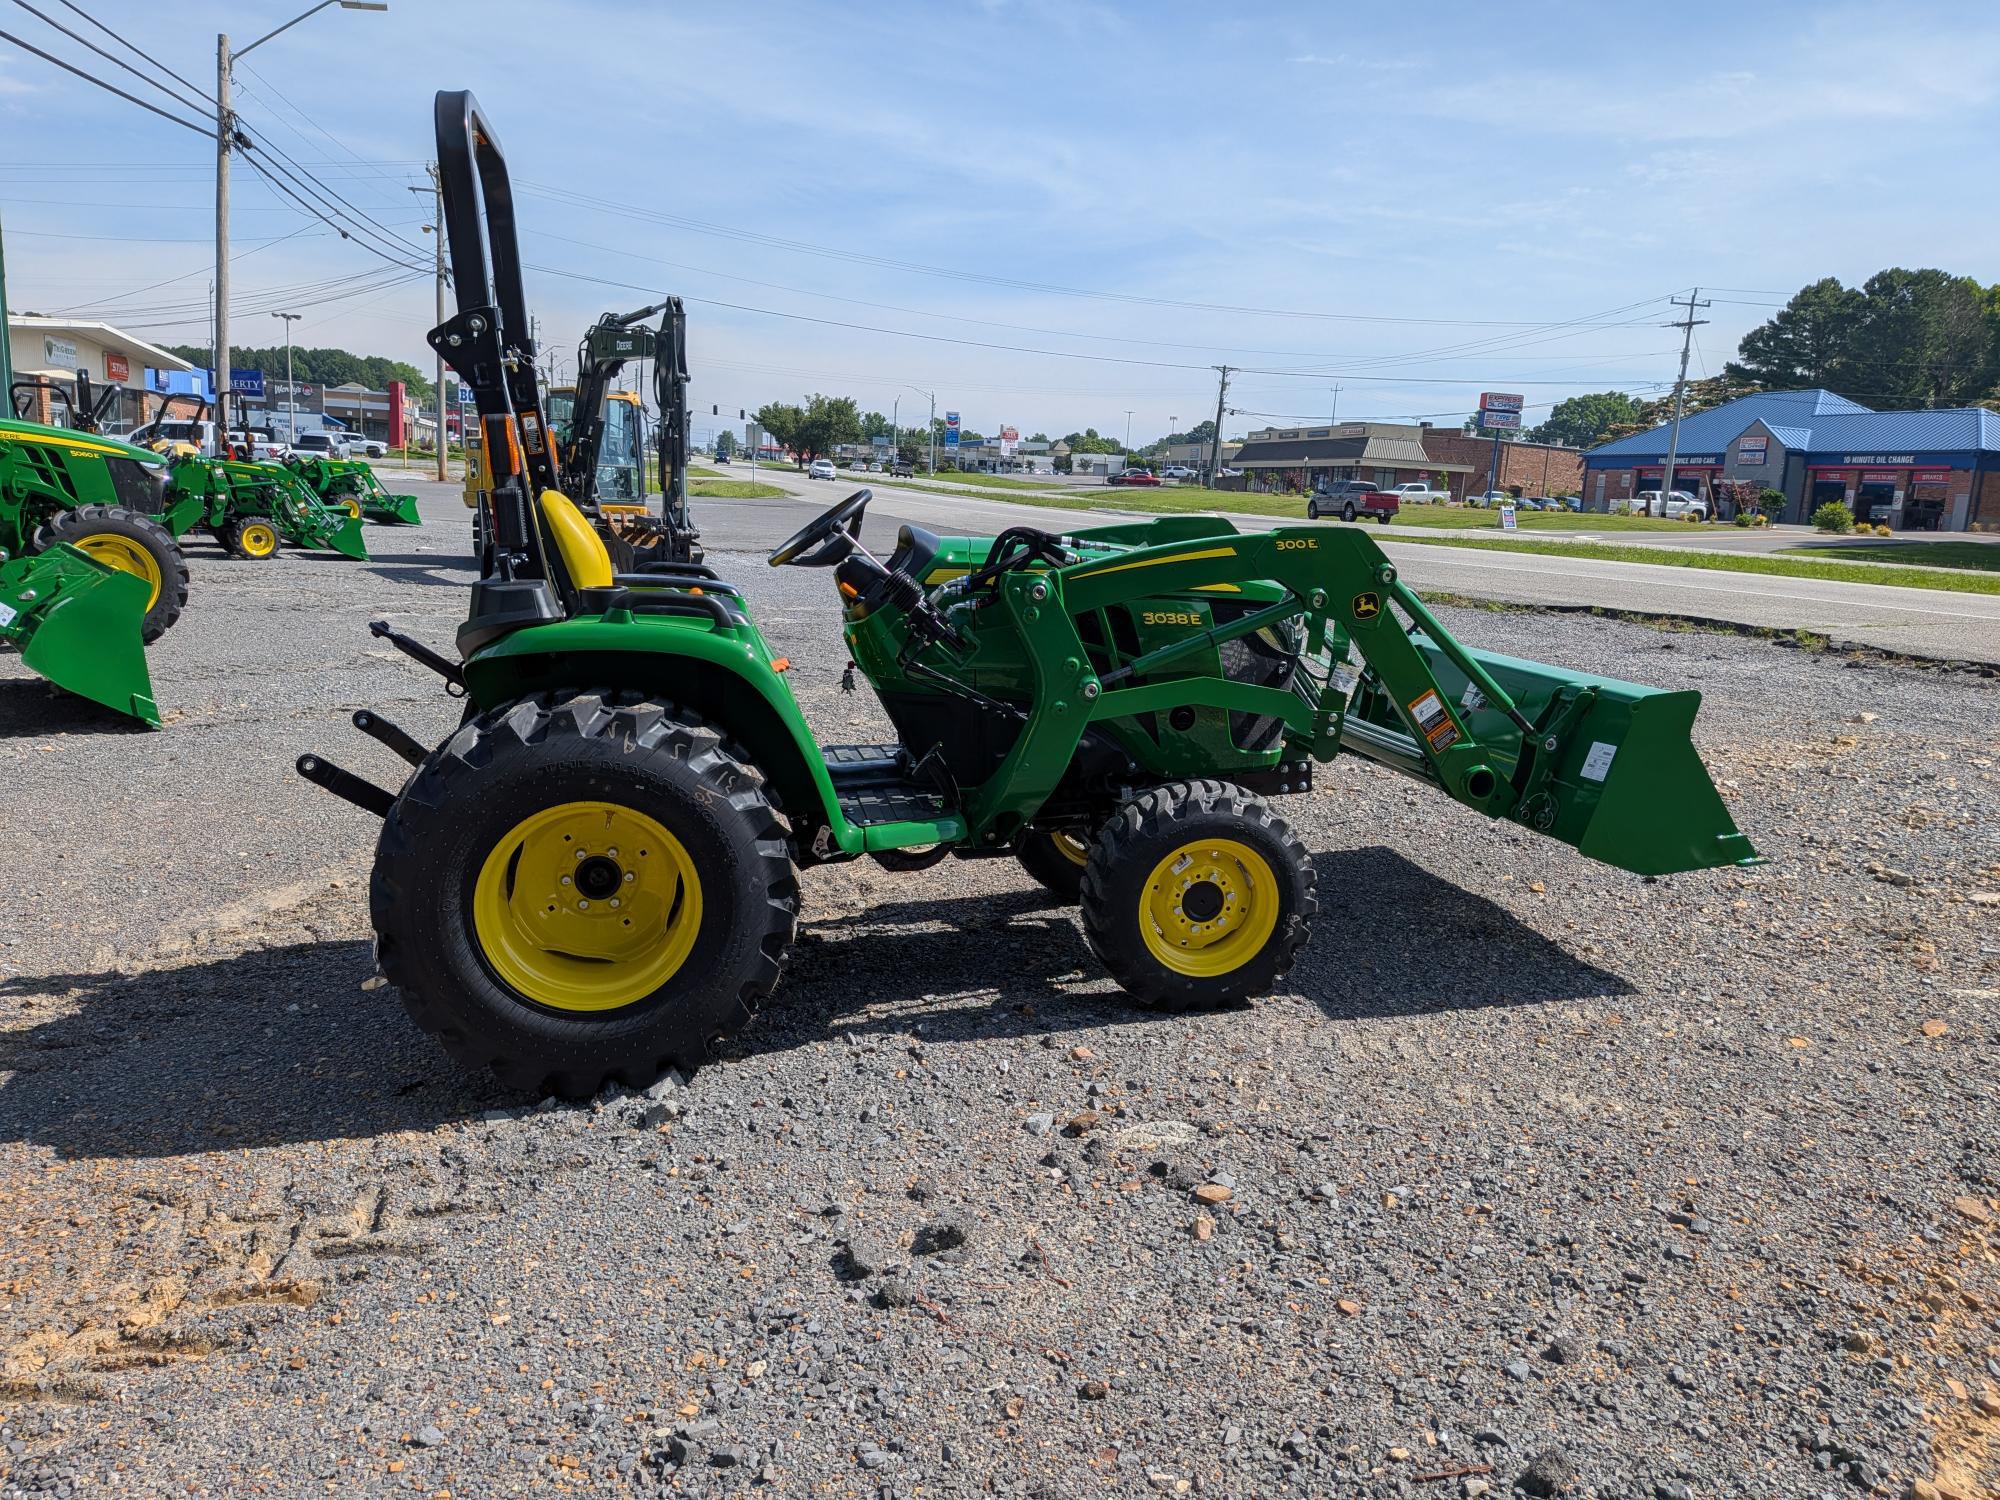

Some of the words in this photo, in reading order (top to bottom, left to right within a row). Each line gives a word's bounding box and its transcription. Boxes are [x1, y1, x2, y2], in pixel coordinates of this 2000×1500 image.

[616, 340, 632, 350] DEERE
[112, 362, 128, 374] STIHL
[274, 384, 302, 396] Weny's
[1488, 394, 1521, 402] EXPRESS
[1843, 456, 1851, 464] 10
[1851, 456, 1875, 464] MINUTE
[1876, 456, 1887, 464] OIL
[1888, 456, 1915, 464] CHANGE
